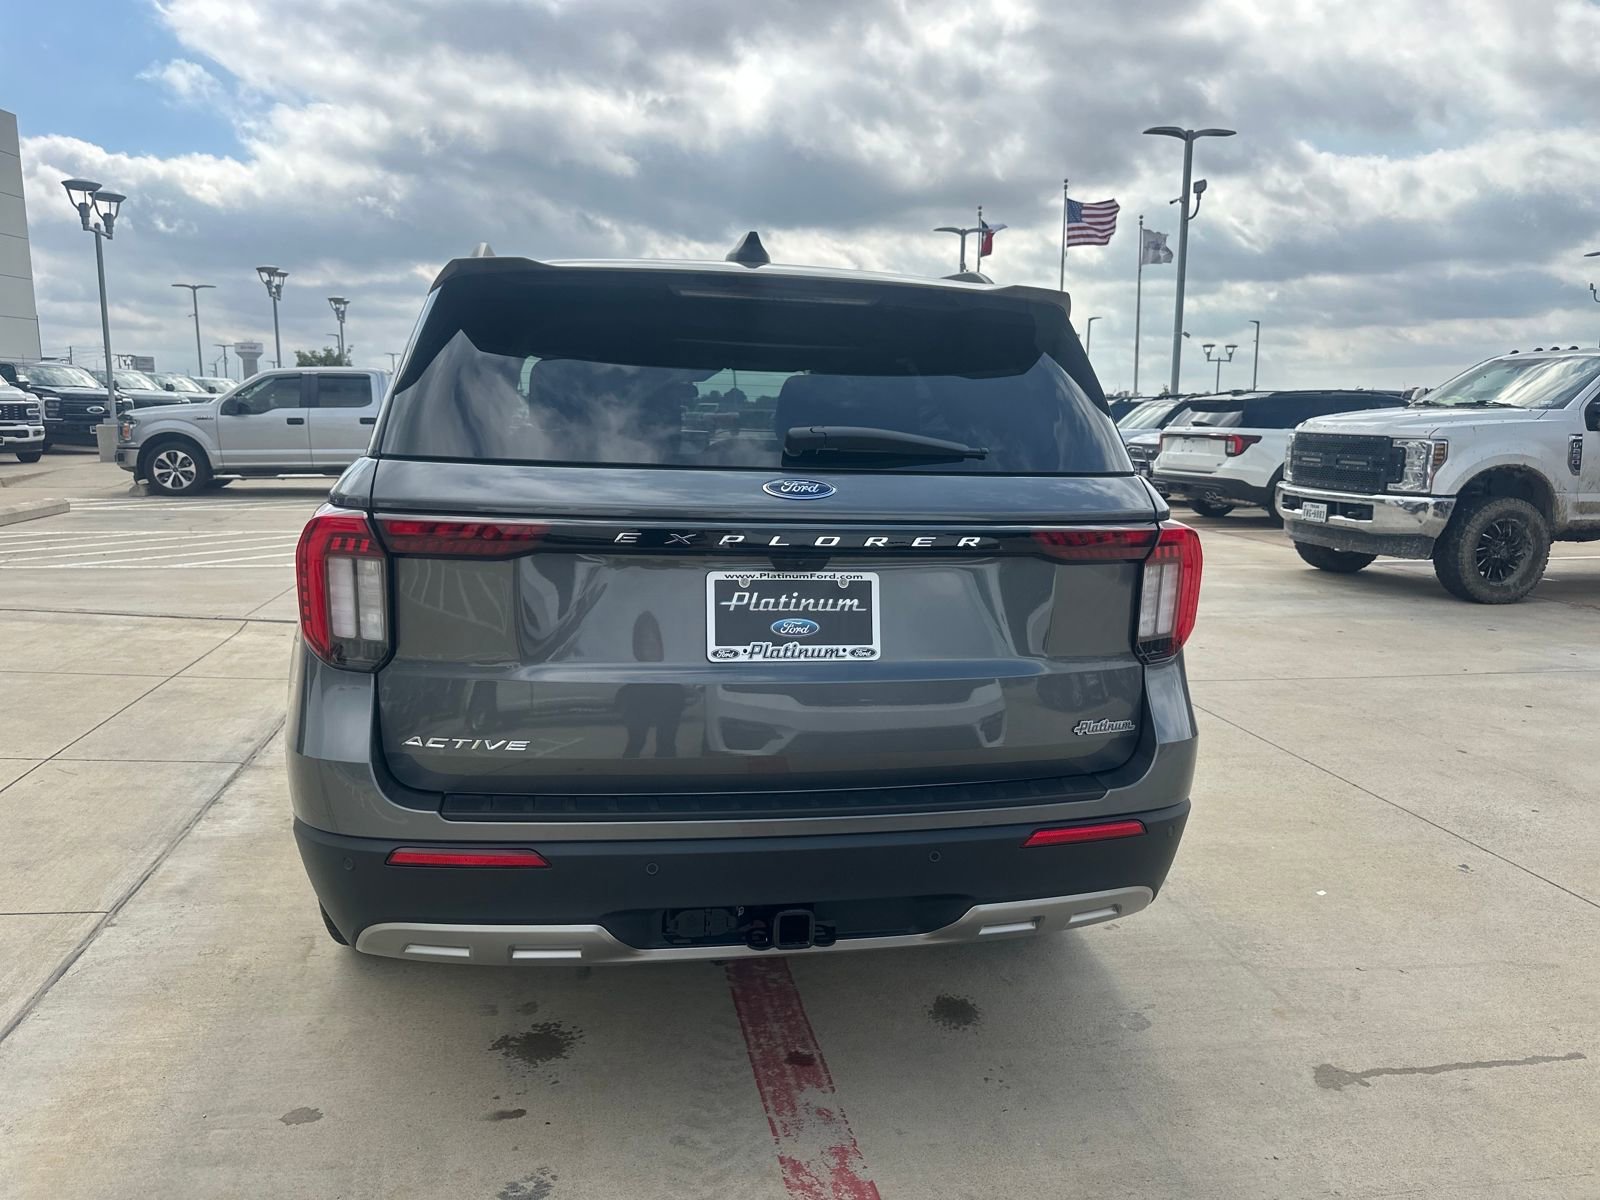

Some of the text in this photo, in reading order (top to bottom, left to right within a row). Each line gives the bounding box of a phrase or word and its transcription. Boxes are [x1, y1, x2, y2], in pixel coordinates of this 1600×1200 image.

[778, 479, 820, 494] Ford
[613, 531, 982, 547] EXPLORER
[724, 572, 863, 580] www.PlatinumFord.com
[719, 591, 867, 612] Platinum
[780, 620, 810, 635] Ford
[744, 642, 847, 660] Platinum
[1074, 719, 1135, 736] Platinum
[401, 735, 530, 751] ACTIVE
